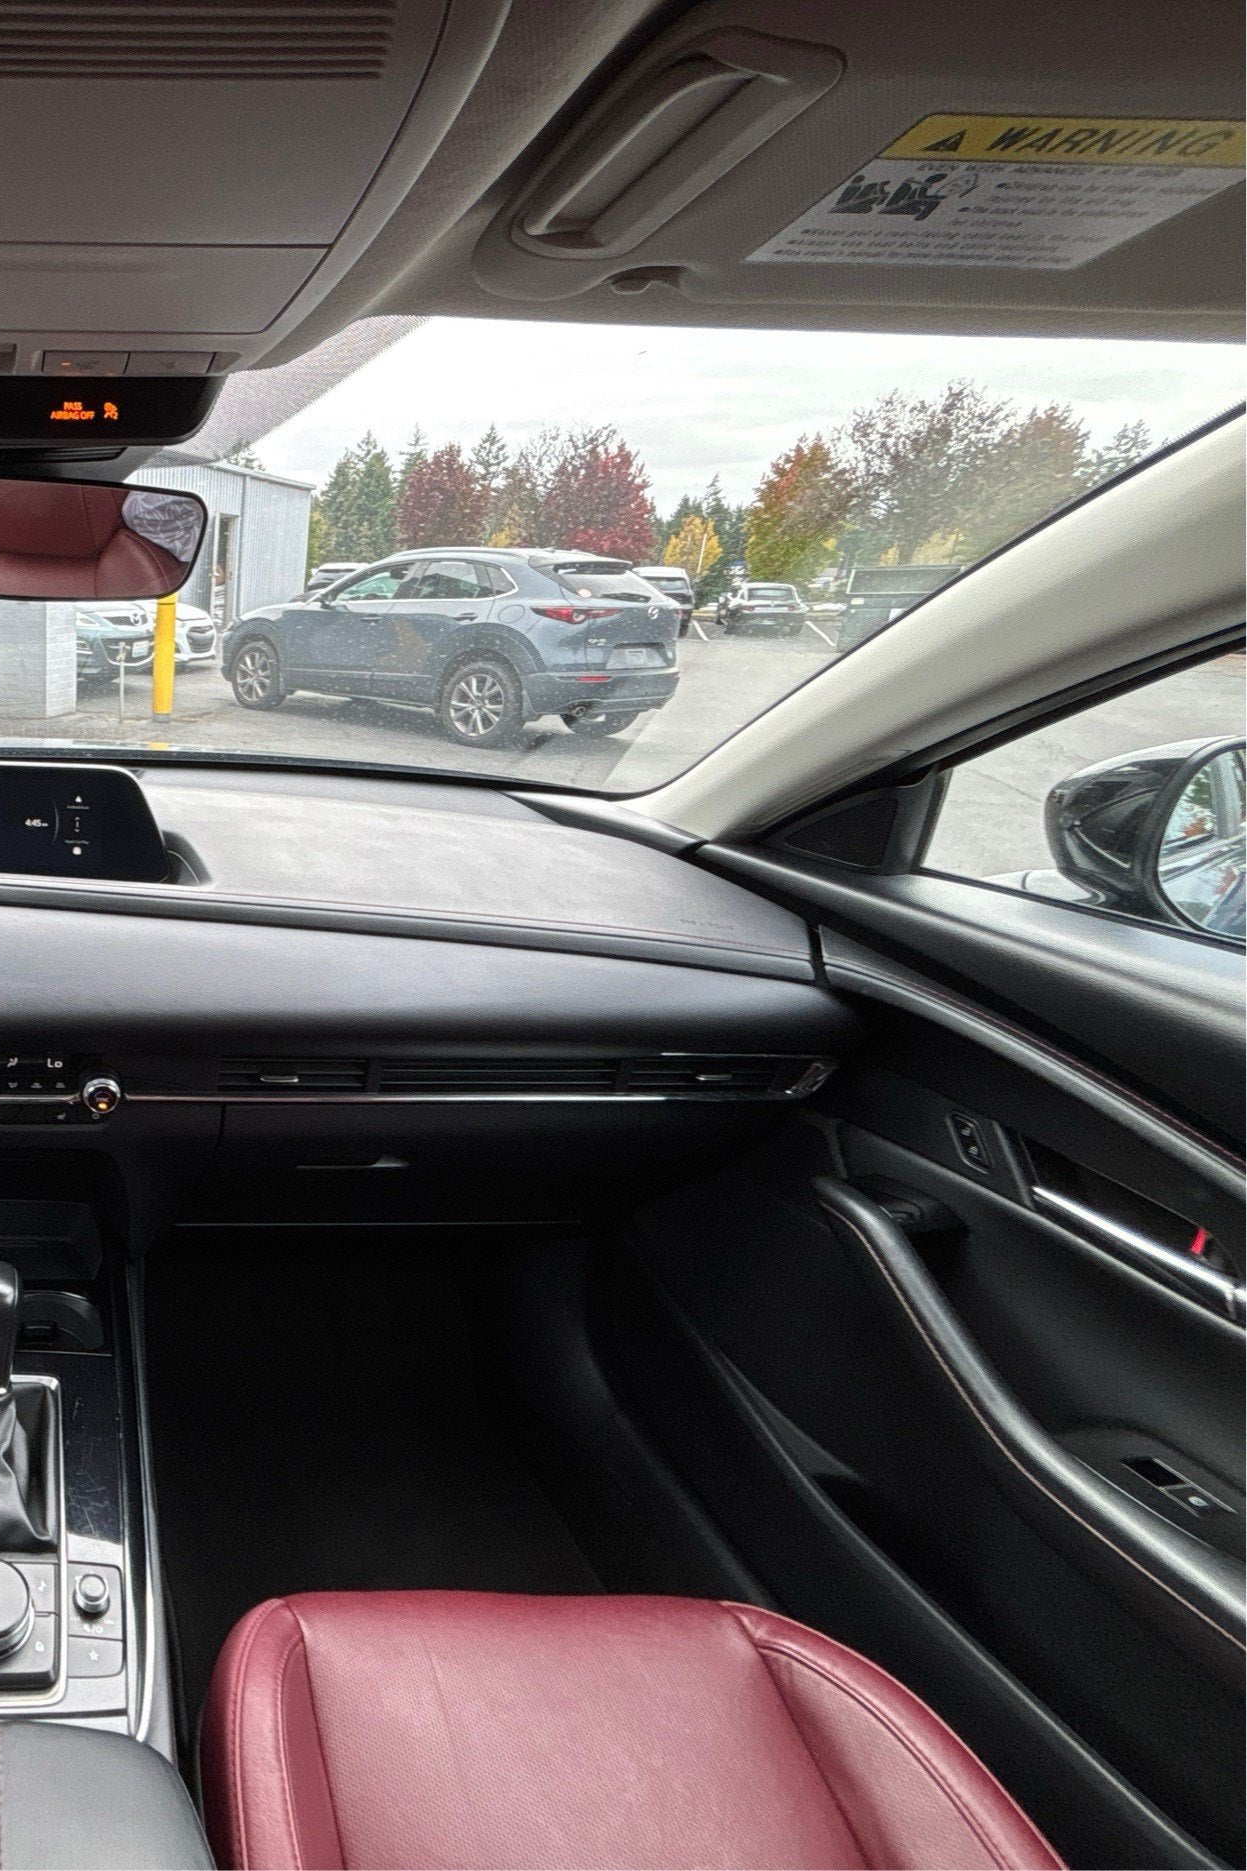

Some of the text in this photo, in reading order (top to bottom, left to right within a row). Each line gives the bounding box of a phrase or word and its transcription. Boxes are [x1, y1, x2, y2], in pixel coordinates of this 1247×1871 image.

[984, 126, 1234, 157] WARNING
[63, 402, 83, 411] PASS
[51, 410, 95, 420] AIRBAG OFF
[47, 1057, 63, 1069] Lo
